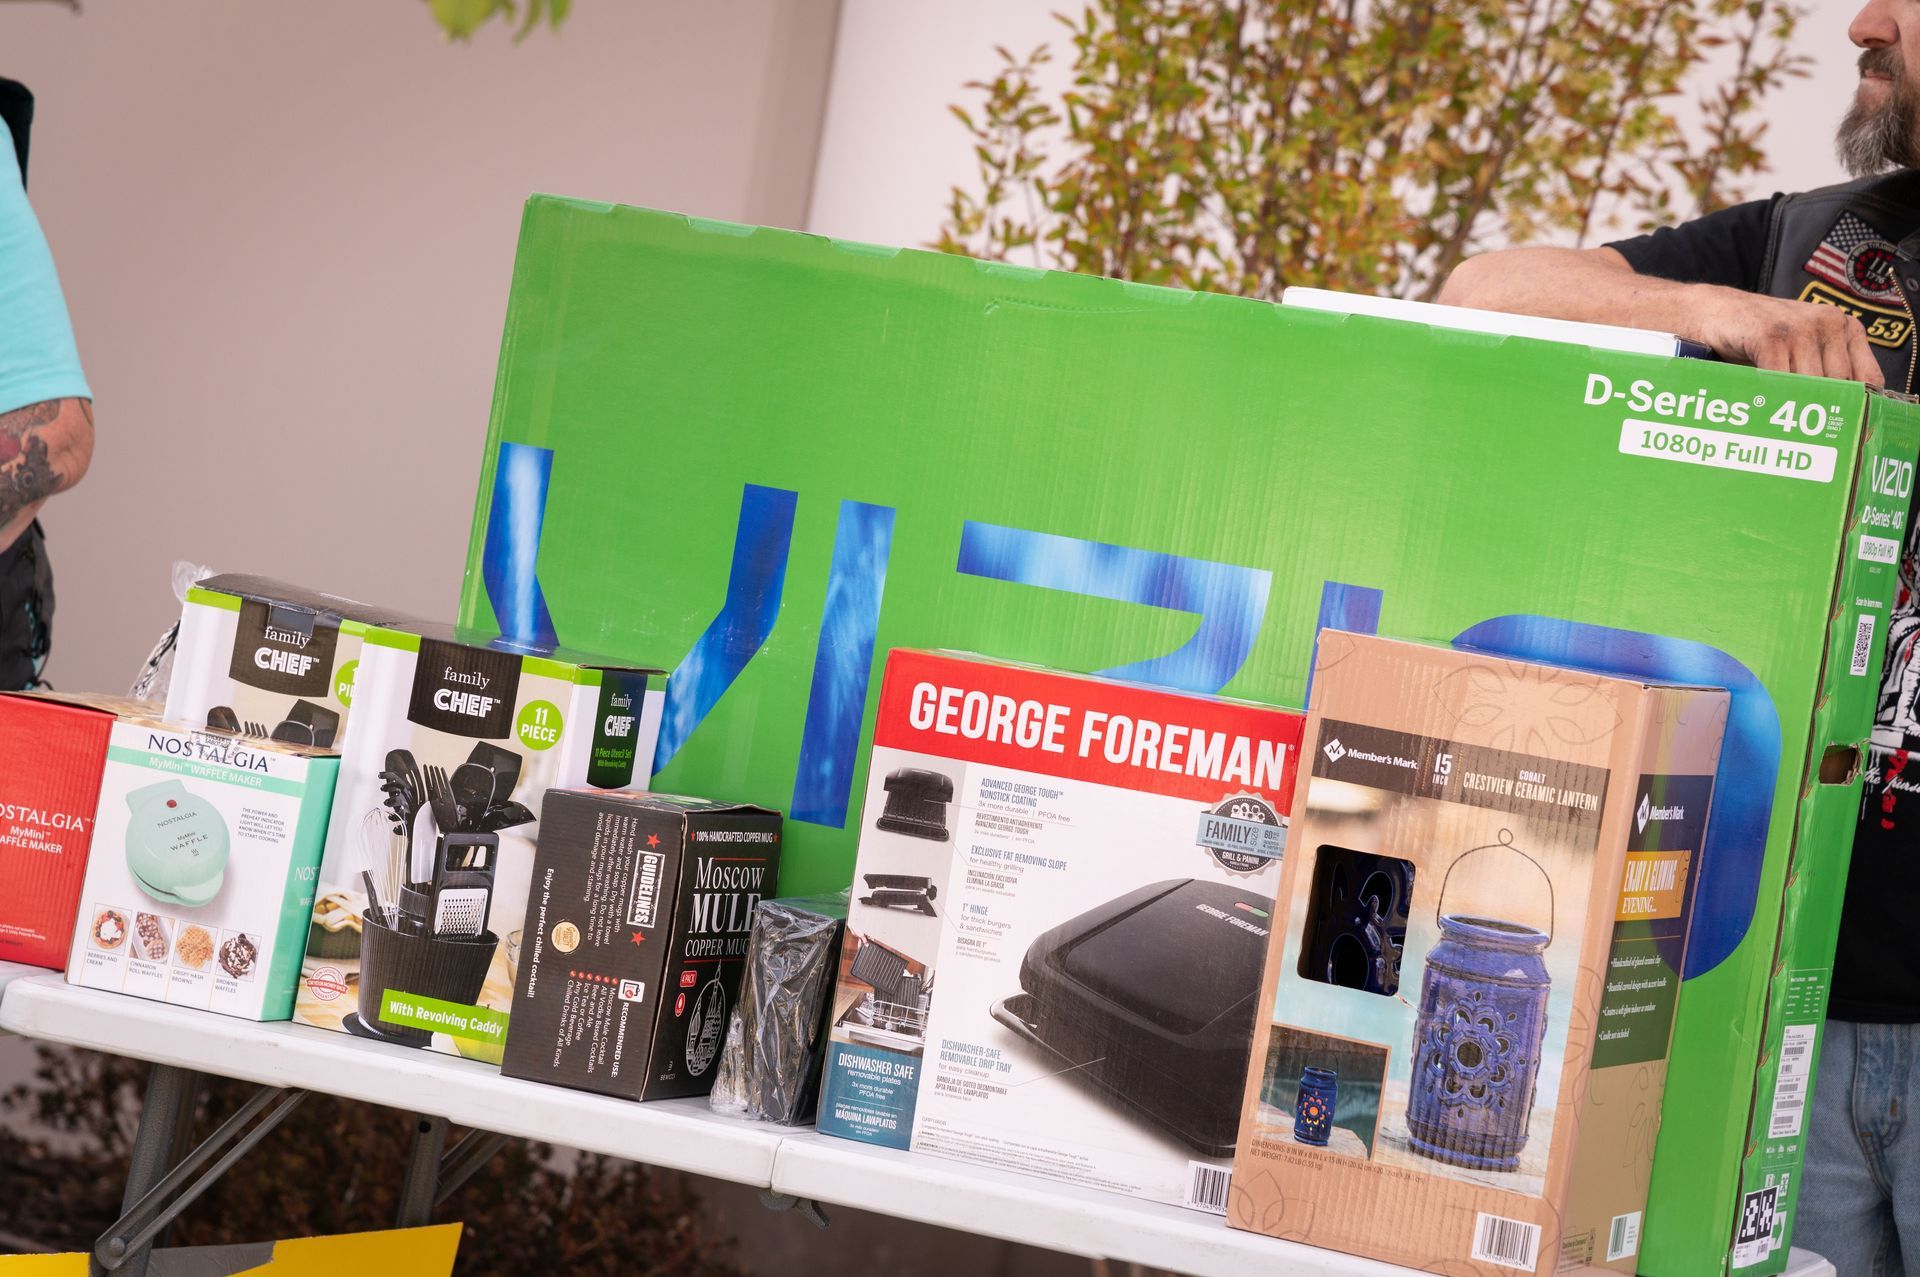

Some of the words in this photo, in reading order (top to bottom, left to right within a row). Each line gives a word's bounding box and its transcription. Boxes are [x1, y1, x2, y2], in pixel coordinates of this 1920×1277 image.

[1867, 317, 1904, 339] 53
[1641, 429, 1717, 462] 1080p
[1724, 441, 1768, 466] Full
[1776, 448, 1813, 471] HD
[1872, 455, 1913, 498] VIZIO
[264, 626, 311, 648] family
[443, 667, 490, 689] family
[610, 692, 632, 710] family
[535, 707, 548, 725] 11
[909, 682, 1070, 753] GEORGE
[520, 724, 557, 743] PIECE
[1347, 748, 1393, 765] Member's
[1434, 753, 1452, 774] 15
[191, 764, 227, 780] WAFFLE
[228, 771, 262, 786] MAKER
[1432, 774, 1448, 786] INCH
[1519, 769, 1546, 784] COBALT
[980, 777, 1012, 791] ADVANCED
[1013, 783, 1037, 795] GEORGE
[1463, 771, 1513, 797] CRESTVIEW
[1515, 781, 1556, 804] CERAMIC
[1557, 788, 1599, 812] LANTERN
[979, 788, 1010, 802] NONSTICK
[1010, 794, 1037, 807] COATING
[157, 811, 198, 828] NOSTALGIA
[596, 812, 604, 831] avoid
[987, 802, 1003, 810] more
[1037, 810, 1057, 819] PFOA
[1057, 814, 1070, 822] free
[1649, 805, 1672, 820] Member's
[620, 816, 628, 835] warm
[629, 817, 638, 836] Hand
[1206, 820, 1251, 844] FAMILY
[1250, 826, 1259, 846] size
[1264, 830, 1273, 839] 60
[170, 834, 208, 851] WAFFLE
[589, 831, 601, 859] damage
[617, 836, 625, 855] water
[626, 837, 634, 854] wash
[696, 831, 709, 842] 100%
[709, 831, 744, 843] HANDCRAFTED
[744, 832, 761, 843] COPPER
[29, 840, 63, 854] MAKER
[1222, 851, 1236, 861] GRILL
[622, 855, 630, 871] your
[970, 845, 1002, 858] EXCLUSIVE
[1002, 850, 1014, 861] FAT
[1014, 853, 1047, 867] REMOVING
[1047, 858, 1067, 870] SLOPE
[979, 858, 1002, 868] healthy
[1003, 862, 1024, 873] grilling
[542, 868, 554, 890] Enjoy
[610, 871, 619, 888] soap.
[618, 872, 627, 896] copper
[1624, 860, 1646, 892] ENJOY
[1652, 859, 1677, 891] GLOWING
[541, 891, 550, 905] the
[582, 874, 594, 903] staining.
[608, 890, 617, 903] Dry
[633, 854, 658, 923] GUIDELINES
[607, 904, 615, 918] with
[614, 897, 623, 916] mugs
[969, 904, 988, 915] HINGE
[535, 906, 547, 935] perfect
[613, 917, 621, 932] with
[1196, 903, 1230, 920] GEORGE
[1224, 915, 1270, 936] FOREMAN
[602, 925, 611, 944] towel
[532, 936, 543, 962] chilled
[685, 939, 722, 957] COPPER
[526, 964, 538, 998] cocktail!
[572, 980, 581, 994] Any
[582, 982, 590, 993] Ice
[599, 985, 607, 995] All
[563, 979, 573, 1003] Chilled
[590, 984, 598, 1000] Beer
[570, 996, 579, 1012] Cold
[596, 996, 605, 1019] Vodka
[605, 987, 615, 1016] Moscow
[390, 1000, 414, 1017] With
[416, 1006, 468, 1030] Revolving
[469, 1017, 503, 1038] Caddy
[559, 1005, 569, 1027] Drinks
[579, 1008, 584, 1016] or
[564, 1014, 575, 1046] Beverage
[574, 1017, 584, 1041] Coffee
[585, 1016, 593, 1028] Ale
[592, 1020, 601, 1041] Based
[602, 1017, 610, 1035] Mule
[613, 1001, 628, 1061] RECOMMENDED
[558, 1028, 565, 1036] of
[552, 1048, 561, 1067] Kinds
[586, 1041, 597, 1073] Cocktails
[597, 1036, 607, 1064] Cocktail
[941, 1039, 1001, 1059] DISHWASHER-SAFE
[610, 1061, 618, 1078] USE:
[838, 1052, 892, 1075] DISHWASHER
[893, 1063, 914, 1079] SAFE
[939, 1050, 977, 1066] REMOVABLE
[978, 1058, 995, 1070] DRIP
[995, 1061, 1011, 1073] TRAY
[847, 1069, 880, 1081] removable
[881, 1076, 901, 1085] plates
[862, 1114, 896, 1129] LAVAPLATOS
